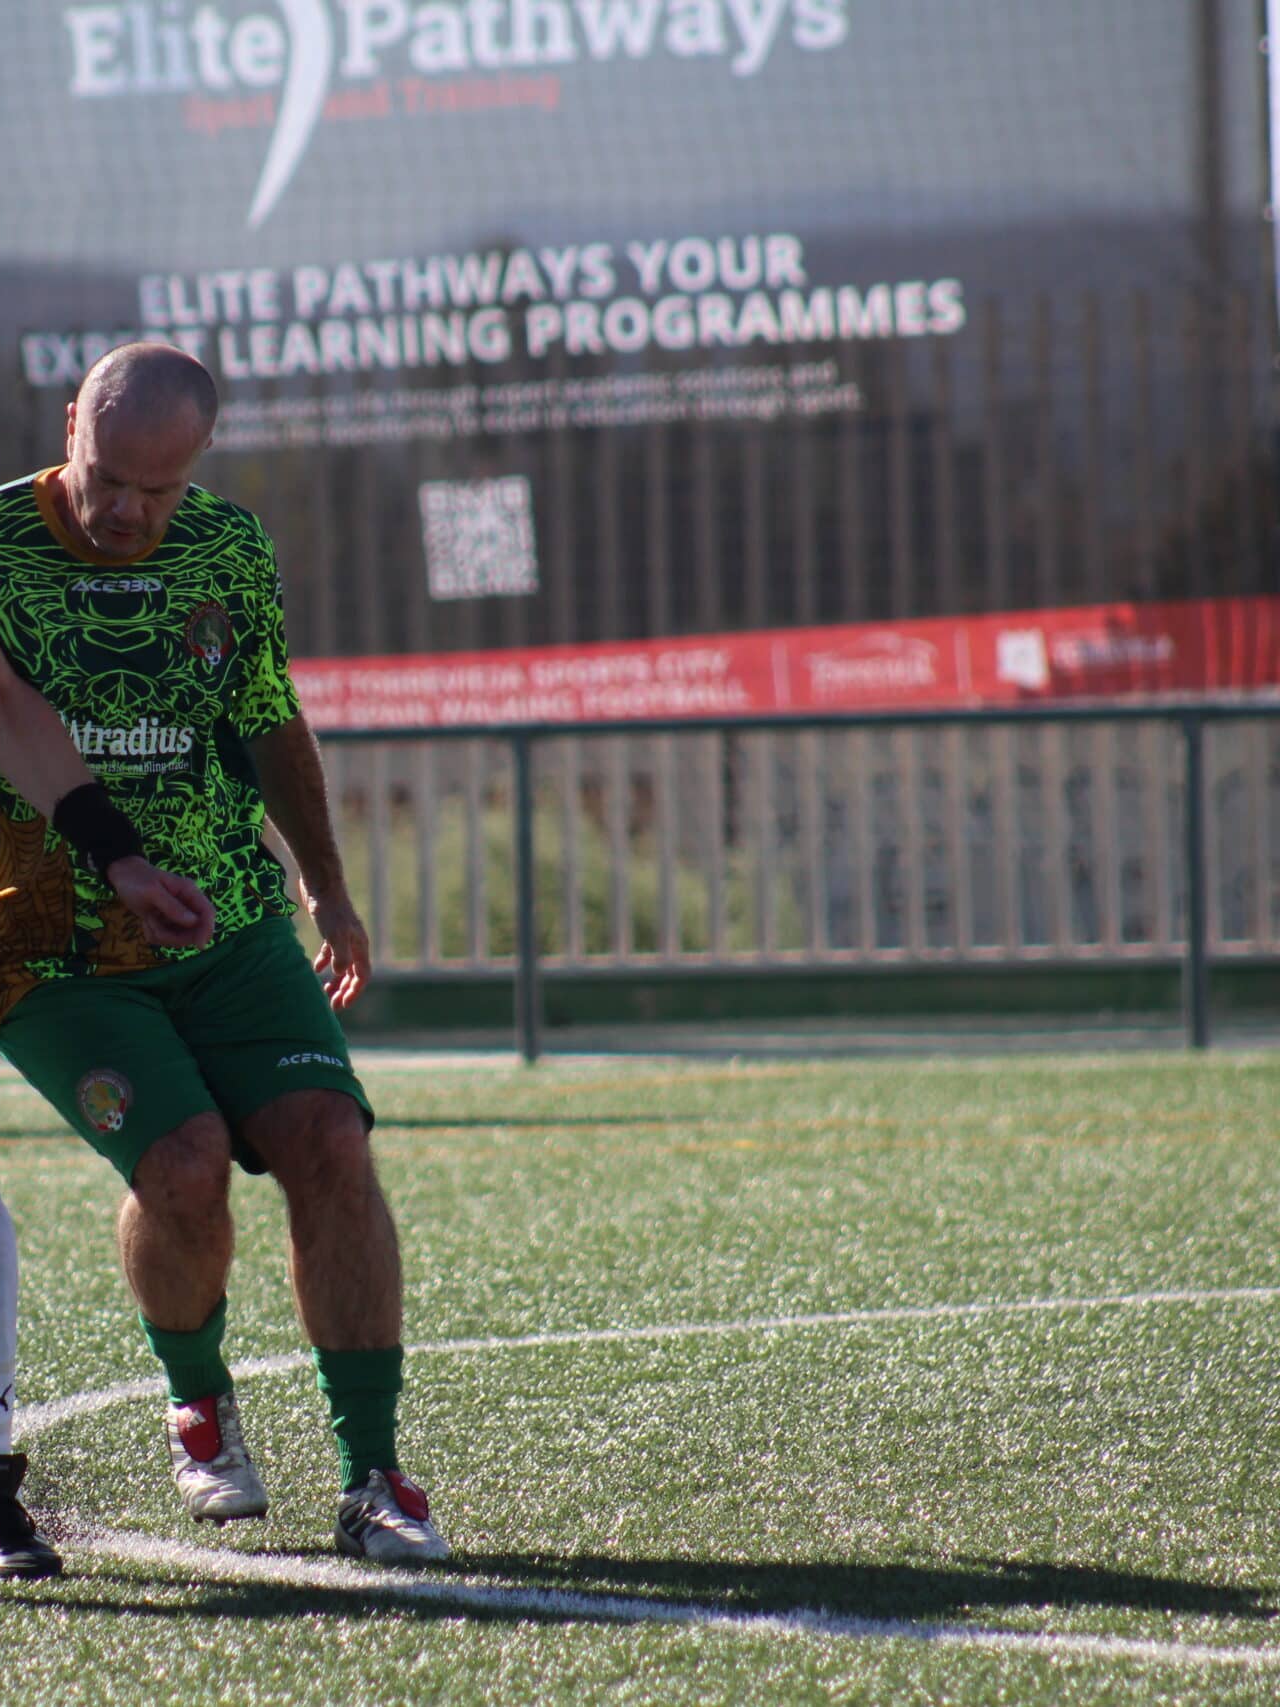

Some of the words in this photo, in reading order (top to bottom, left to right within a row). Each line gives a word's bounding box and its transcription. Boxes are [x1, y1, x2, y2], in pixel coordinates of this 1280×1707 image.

[68, 0, 285, 96] Elite
[339, 0, 850, 77] Pathways
[141, 270, 279, 326] ELITE
[296, 245, 612, 316] PATHWAYS
[630, 235, 805, 293] YOUR
[23, 331, 206, 385] EXPT
[221, 311, 512, 378] LEARNING
[525, 280, 965, 355] PROGRAMMES
